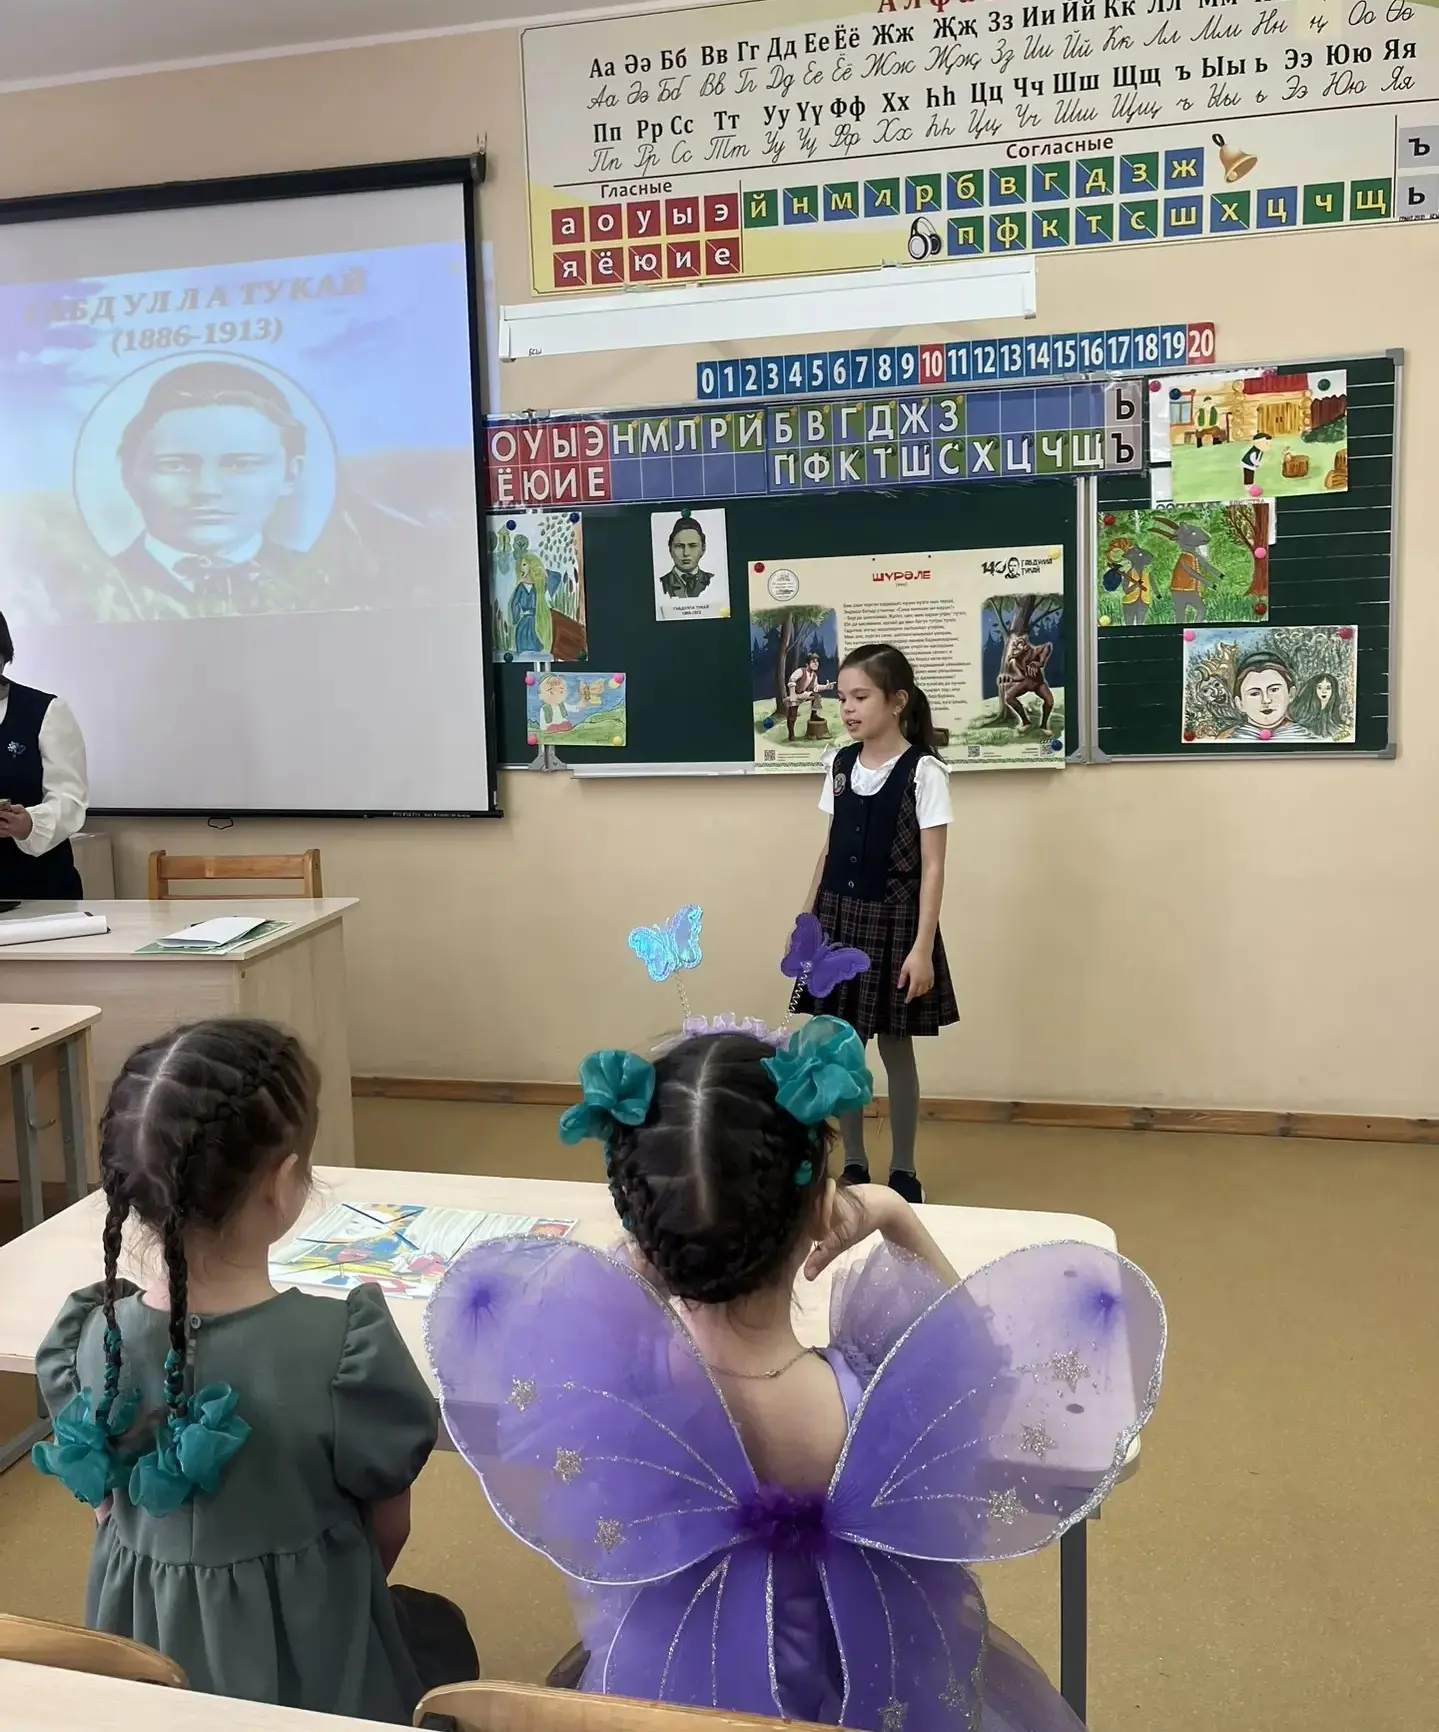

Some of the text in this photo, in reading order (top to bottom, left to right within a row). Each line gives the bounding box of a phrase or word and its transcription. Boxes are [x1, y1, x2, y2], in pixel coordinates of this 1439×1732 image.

[589, 58, 616, 78] Аа
[625, 54, 651, 74] Әә
[660, 48, 687, 70] Бб
[701, 46, 728, 66] Вв
[737, 41, 760, 62] Гг
[767, 37, 797, 63] Дд
[804, 33, 830, 53] Ее
[834, 24, 860, 50] Ёё
[872, 23, 914, 46] Жж
[933, 16, 978, 41] Җҗ
[988, 11, 1013, 32] Зз
[1022, 6, 1055, 28] Ии
[1062, 0, 1095, 23] Йй
[1104, 0, 1136, 19] Кк
[593, 39, 1416, 143] Пп Рр Сс Тт Уу Үү Фф Хх Һһ Цц Чч Шш Щщ ъ Ыы ь Ээ Юю Яя
[1006, 137, 1113, 158] Согласные
[601, 182, 672, 198] Гласные
[751, 158, 1197, 218] й н м л р б в г д з ж
[561, 204, 729, 235] а о у ы э
[958, 189, 1386, 249] п ф к т с ш х ц ч щ
[563, 247, 730, 278] я ё ю и е
[22, 287, 231, 325] БДУЛЛА
[112, 318, 283, 357] (1886-1913)
[701, 329, 1213, 394] 0 1 2 3 4 5 6 7 8 9 10 11 12 13 14 15 16 17 18 19 20
[491, 388, 1134, 462] О У Ы Э Н М Л Р Й Б В Г Д Ж З Ь
[498, 432, 1135, 501] Ё Ю И Е П Ф К Т Ш С Х Ц Ч Щ Ъ
